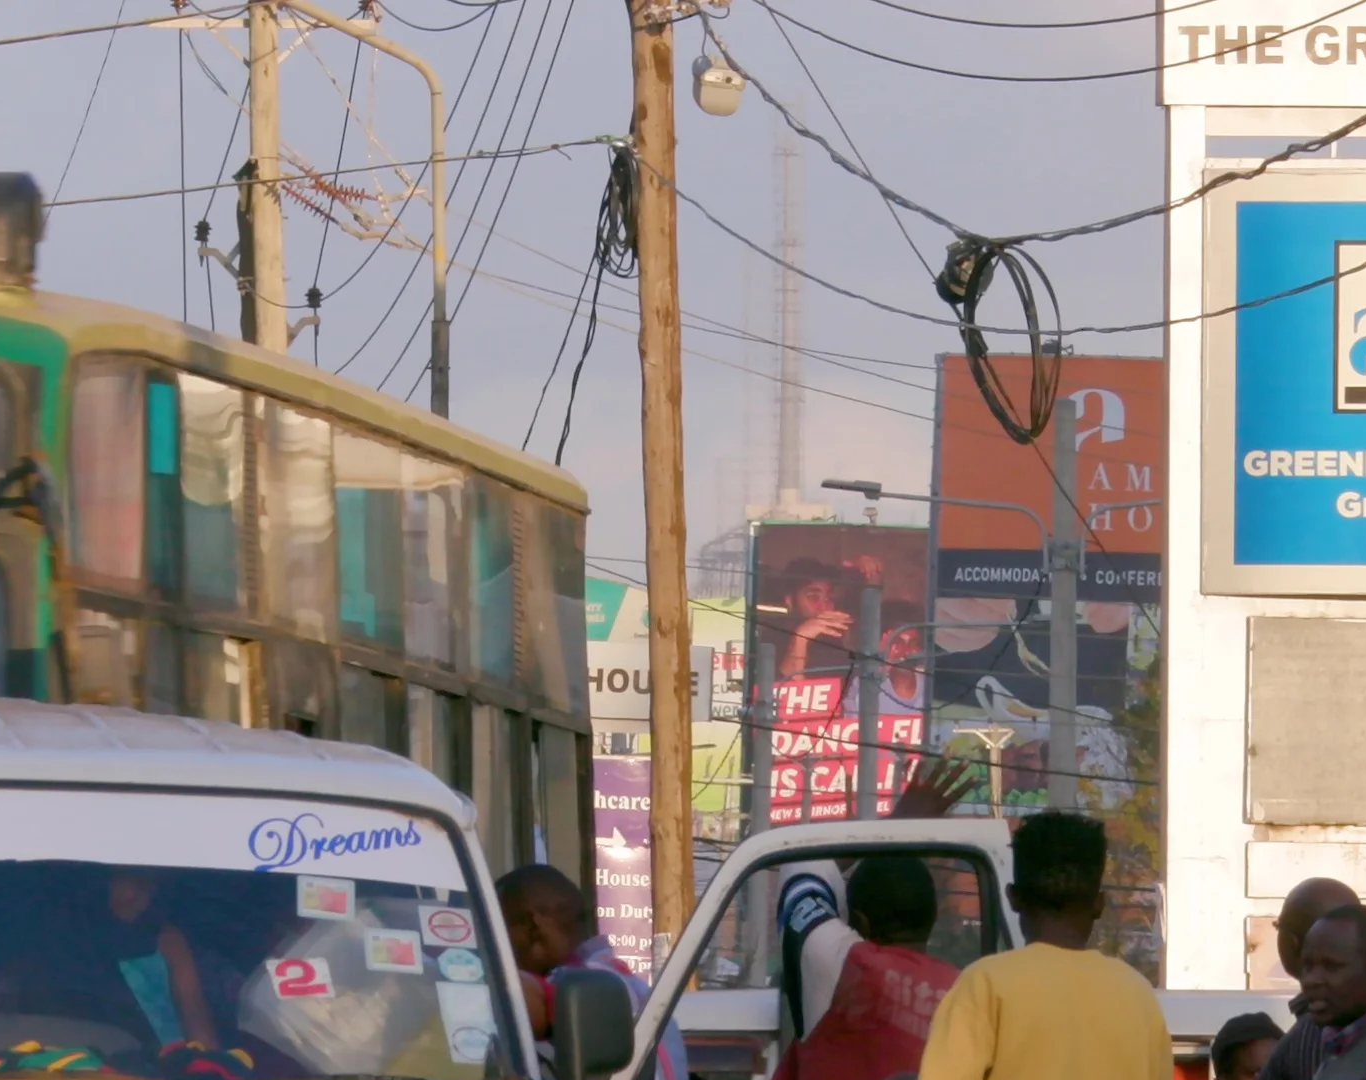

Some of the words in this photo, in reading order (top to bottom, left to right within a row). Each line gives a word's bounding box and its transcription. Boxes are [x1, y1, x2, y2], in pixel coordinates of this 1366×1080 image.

[1178, 26, 1285, 65] THE
[248, 812, 421, 872] Dreams
[596, 868, 650, 886] House
[608, 934, 636, 947] 8:00
[275, 958, 329, 997] 2
